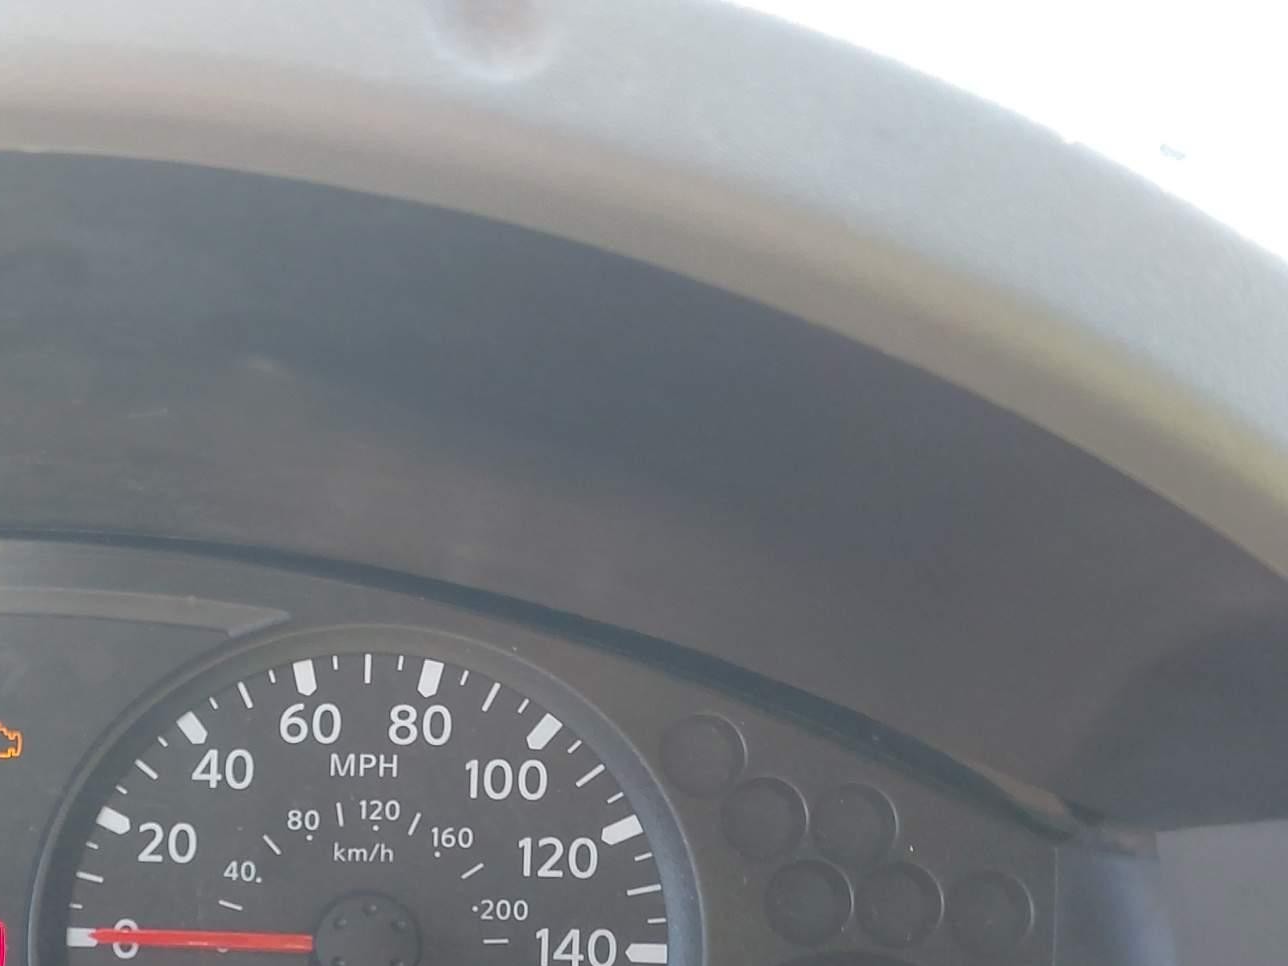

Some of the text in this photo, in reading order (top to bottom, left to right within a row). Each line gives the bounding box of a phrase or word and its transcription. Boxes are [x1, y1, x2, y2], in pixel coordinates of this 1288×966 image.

[280, 704, 341, 743] 60
[389, 705, 451, 745] 80
[192, 750, 253, 789] 40
[331, 754, 397, 777] MPH
[466, 760, 547, 800] 100
[288, 810, 319, 830] 80
[360, 800, 399, 820] 120
[139, 823, 196, 863] 20
[334, 843, 393, 861] km/h
[432, 828, 472, 848] 160
[519, 837, 597, 878] 120
[481, 900, 528, 920] 200
